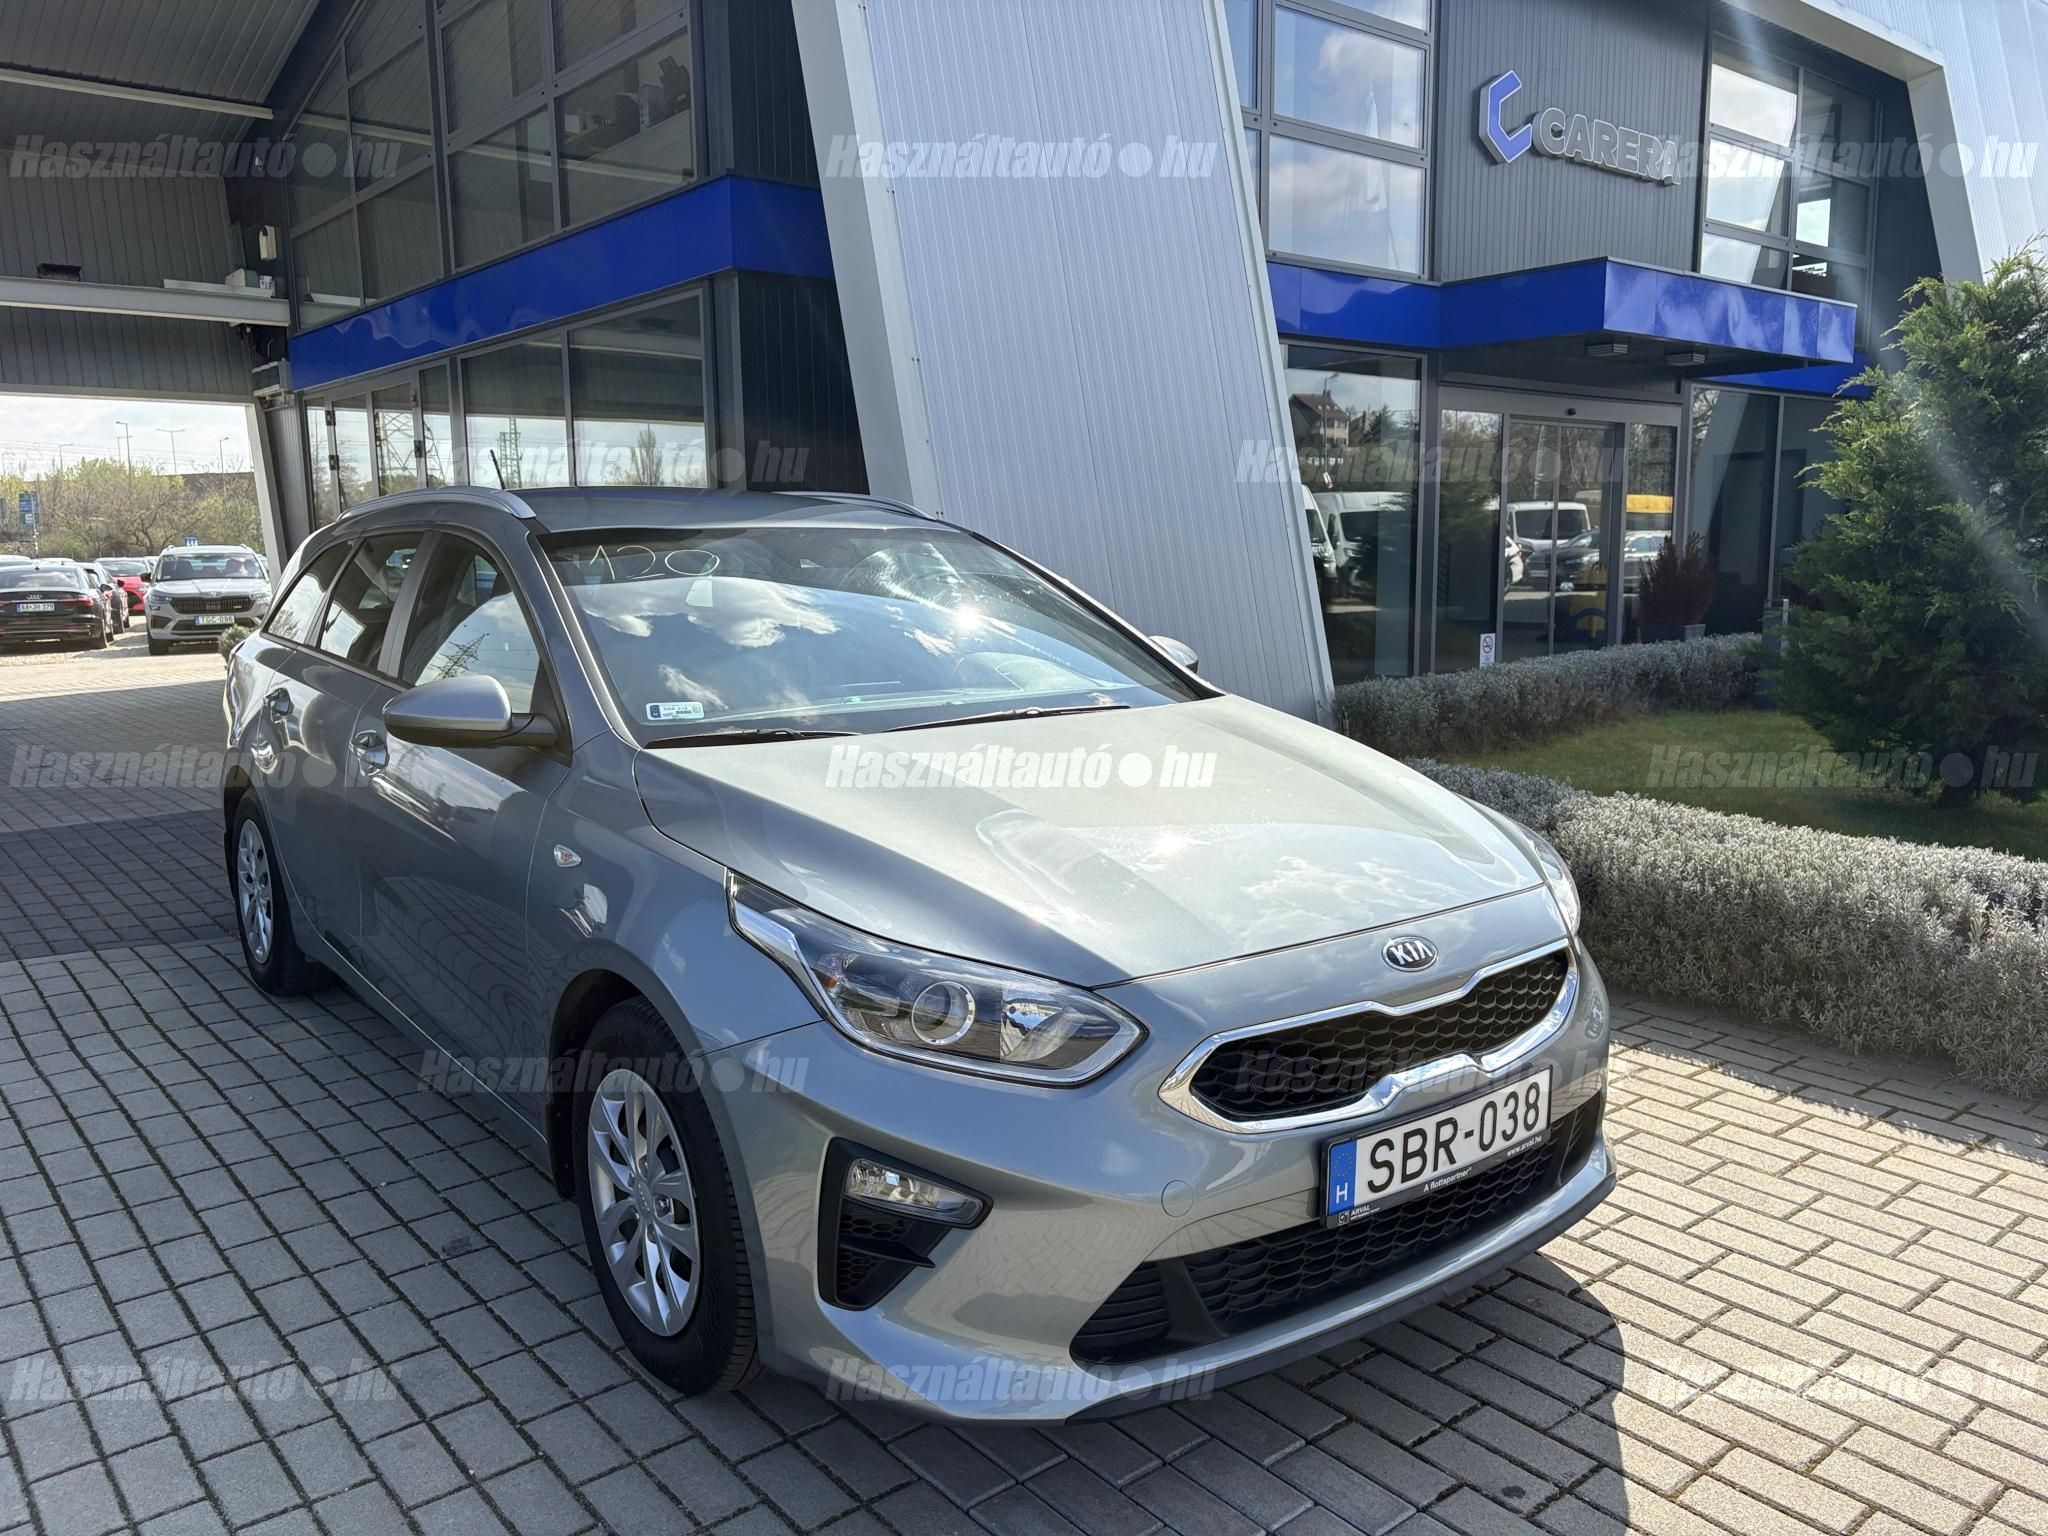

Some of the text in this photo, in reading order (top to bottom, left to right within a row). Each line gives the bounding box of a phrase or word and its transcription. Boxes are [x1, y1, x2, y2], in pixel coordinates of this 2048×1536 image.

[1534, 107, 1681, 186] CARERA
[1390, 940, 1433, 965] KIA
[1368, 1082, 1540, 1194] SBR-038
[1335, 1182, 1349, 1205] H
[1350, 1204, 1371, 1216] ARVAL
